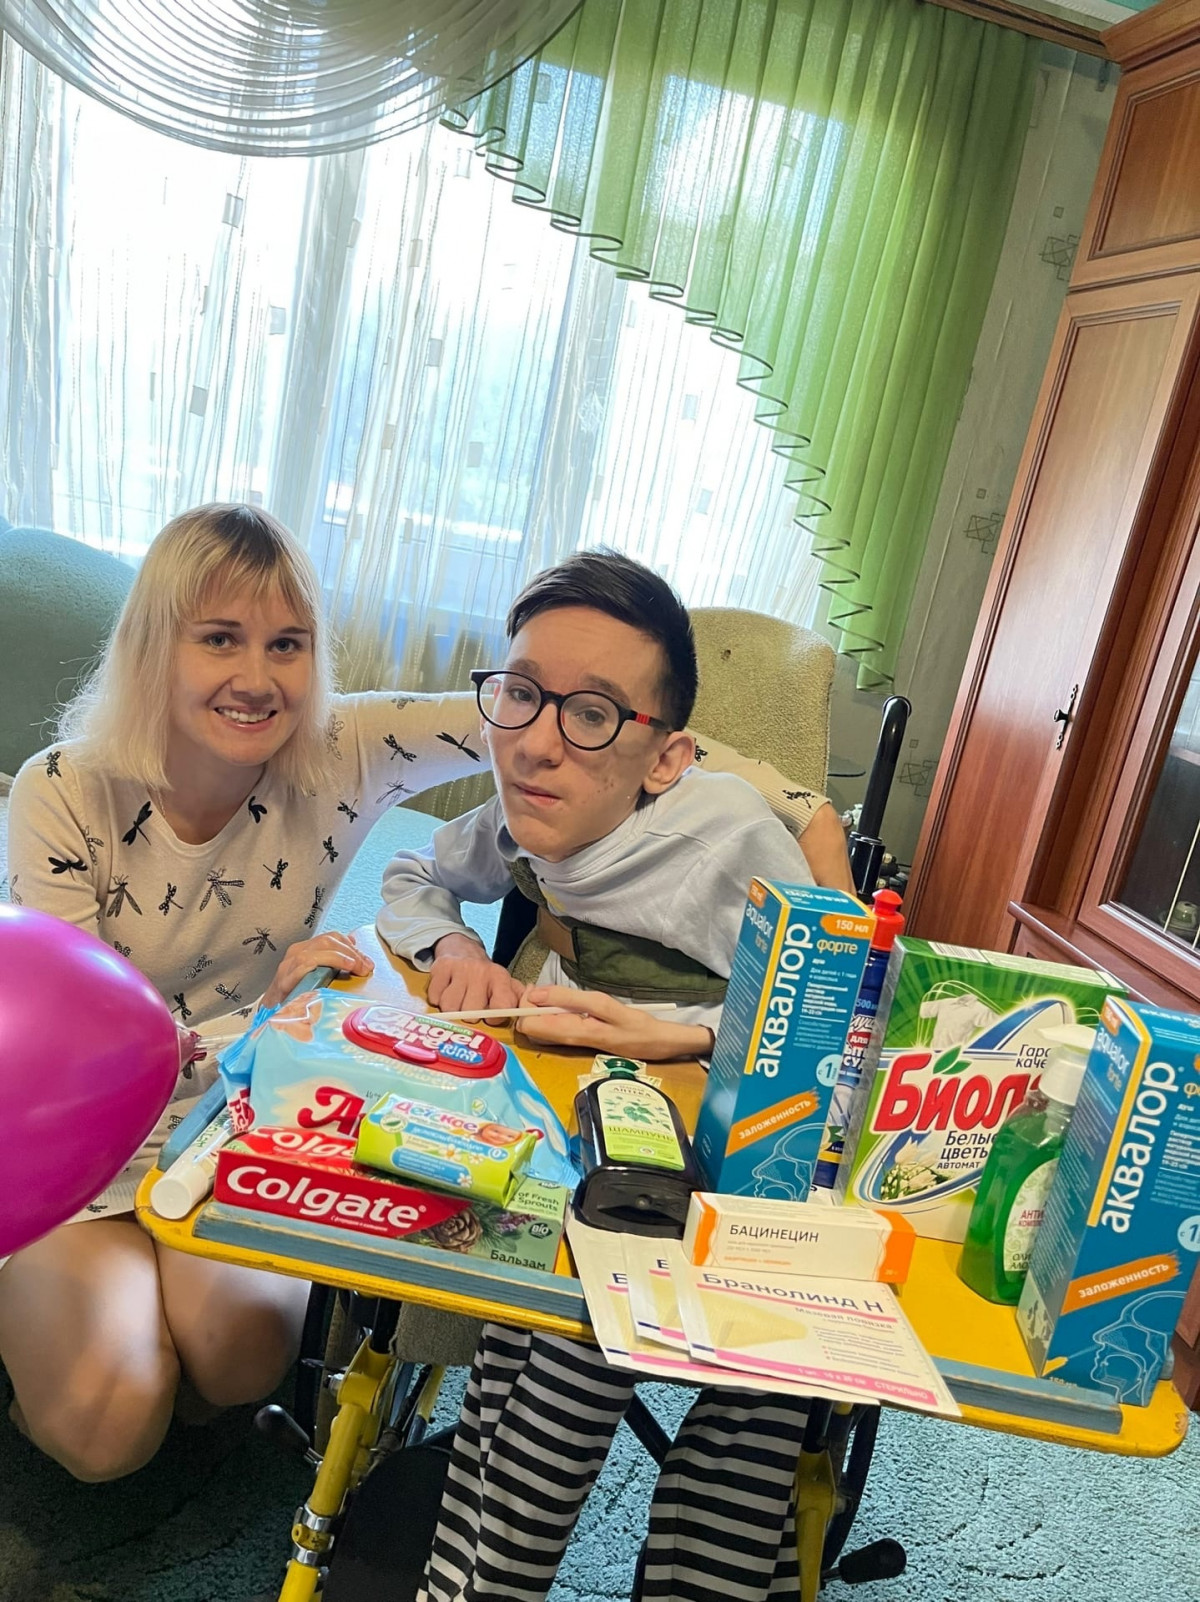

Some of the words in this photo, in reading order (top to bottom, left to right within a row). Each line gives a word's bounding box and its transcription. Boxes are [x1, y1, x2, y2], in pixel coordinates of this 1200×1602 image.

[745, 904, 774, 938] aqualor
[836, 919, 854, 930] 150
[854, 923, 869, 933] мл
[816, 939, 858, 956] форте
[755, 923, 813, 1078] аквалор
[376, 1009, 486, 1050] Angel
[873, 1052, 1043, 1132] Биол
[394, 1100, 479, 1132] Детское
[739, 1099, 812, 1140] заложенность
[1101, 1062, 1179, 1233] аквалор
[936, 1161, 981, 1169] АВТОМАТ
[227, 1166, 420, 1228] Colgate
[518, 1197, 559, 1211] Sprouts
[532, 1193, 559, 1205] Fresh
[730, 1224, 819, 1243] БАЦИНЕЦИН
[491, 1250, 546, 1272] Бальзам
[702, 1273, 859, 1310] Бранолинд
[863, 1300, 885, 1313] Н
[1078, 1263, 1170, 1298] заложенность
